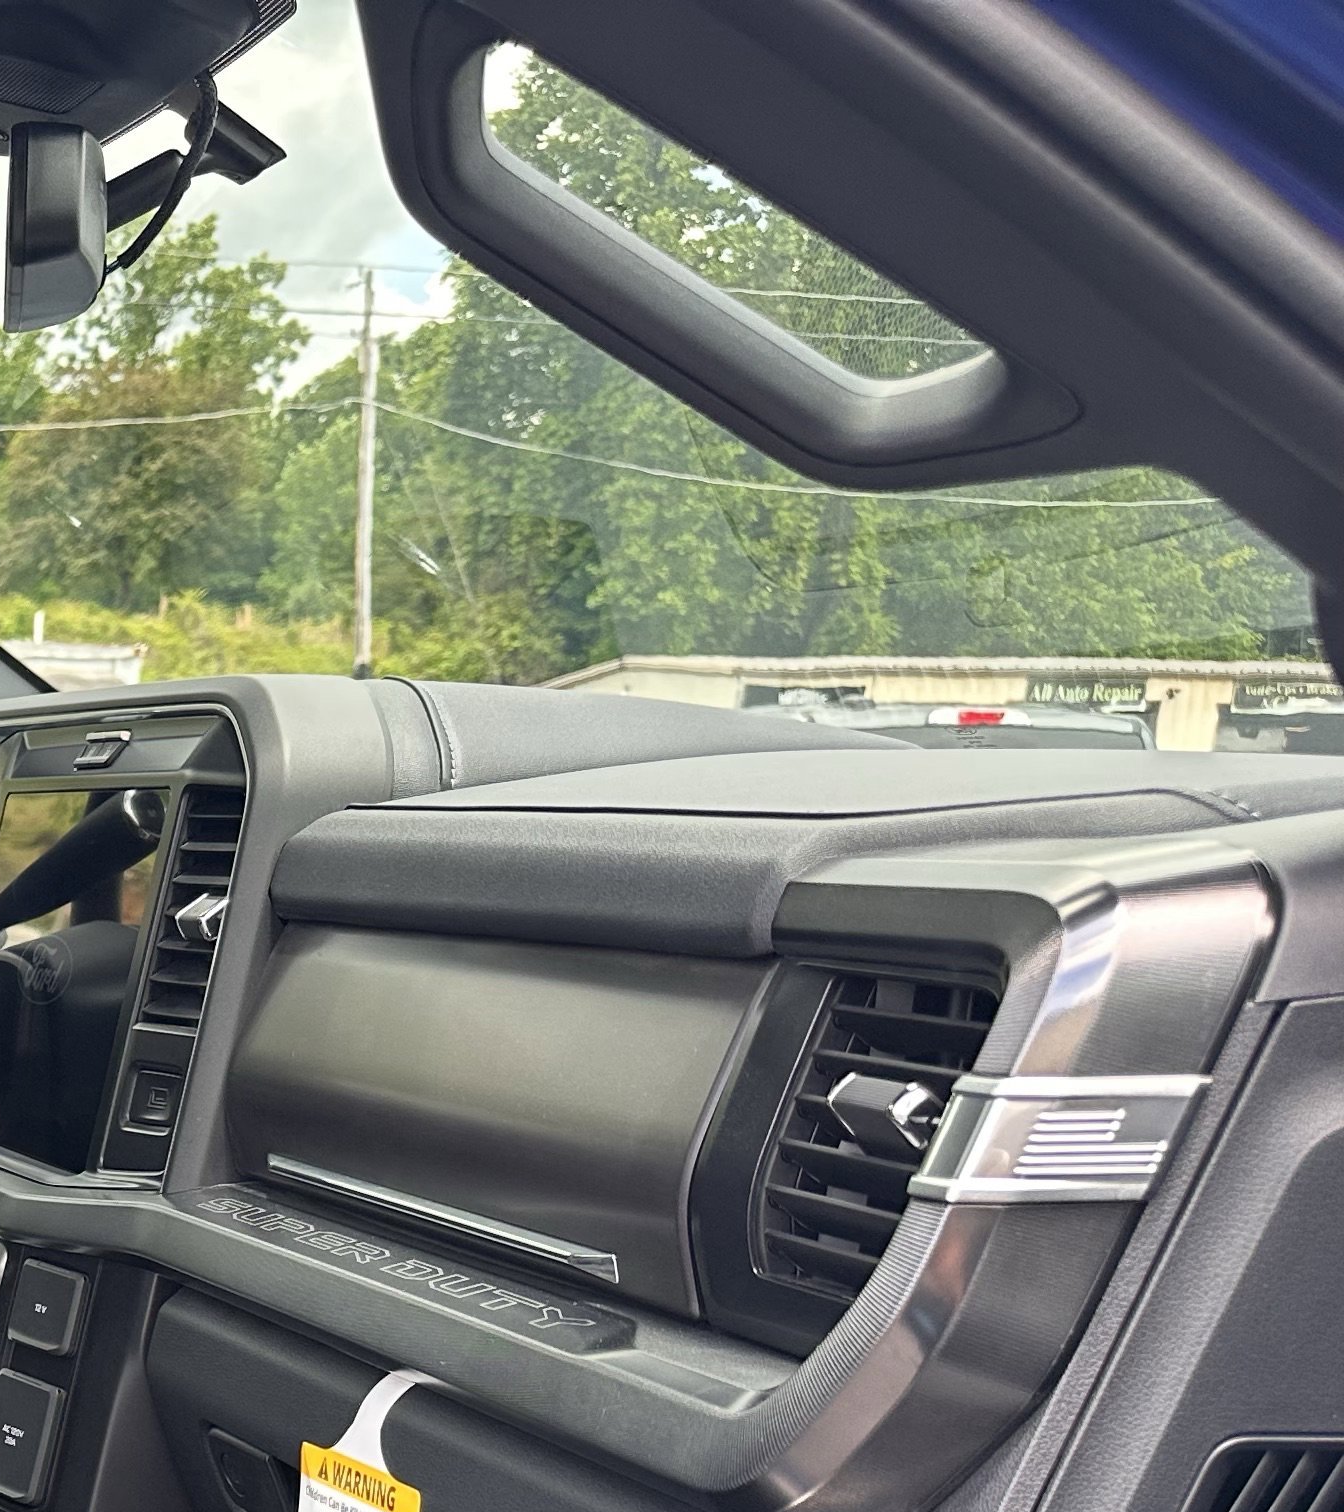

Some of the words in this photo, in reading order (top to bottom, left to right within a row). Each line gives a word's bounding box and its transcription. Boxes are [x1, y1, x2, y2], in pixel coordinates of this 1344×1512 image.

[1031, 682, 1052, 701] All
[1054, 684, 1089, 702] Auto
[1093, 682, 1142, 703] Repair
[25, 943, 65, 993] Ford
[197, 1197, 390, 1265] SUPER
[385, 1258, 596, 1330] DUTY
[305, 1484, 327, 1506] Children
[328, 1496, 339, 1511] Can
[332, 1460, 397, 1512] WARNING
